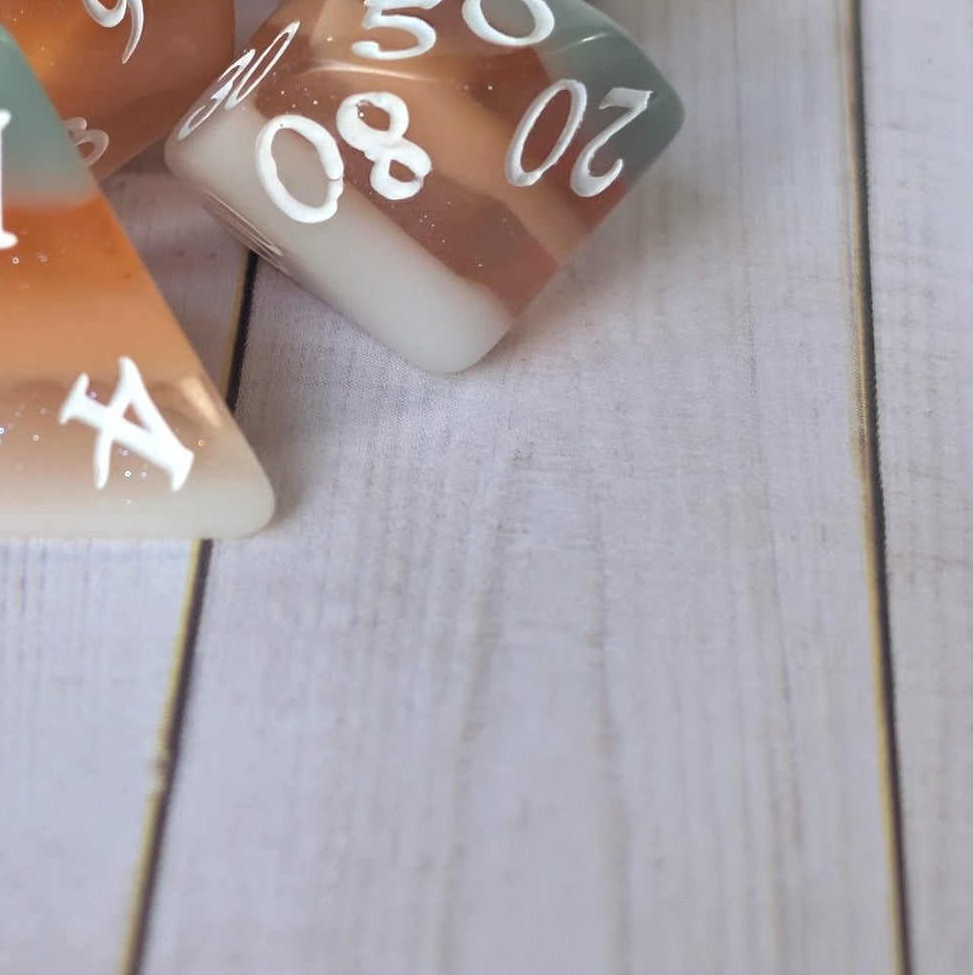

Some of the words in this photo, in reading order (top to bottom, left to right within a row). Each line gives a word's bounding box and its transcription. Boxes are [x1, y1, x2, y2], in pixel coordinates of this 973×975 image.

[177, 20, 300, 141] 30
[505, 78, 653, 198] 20
[254, 91, 432, 224] 80
[58, 355, 195, 492] 4
